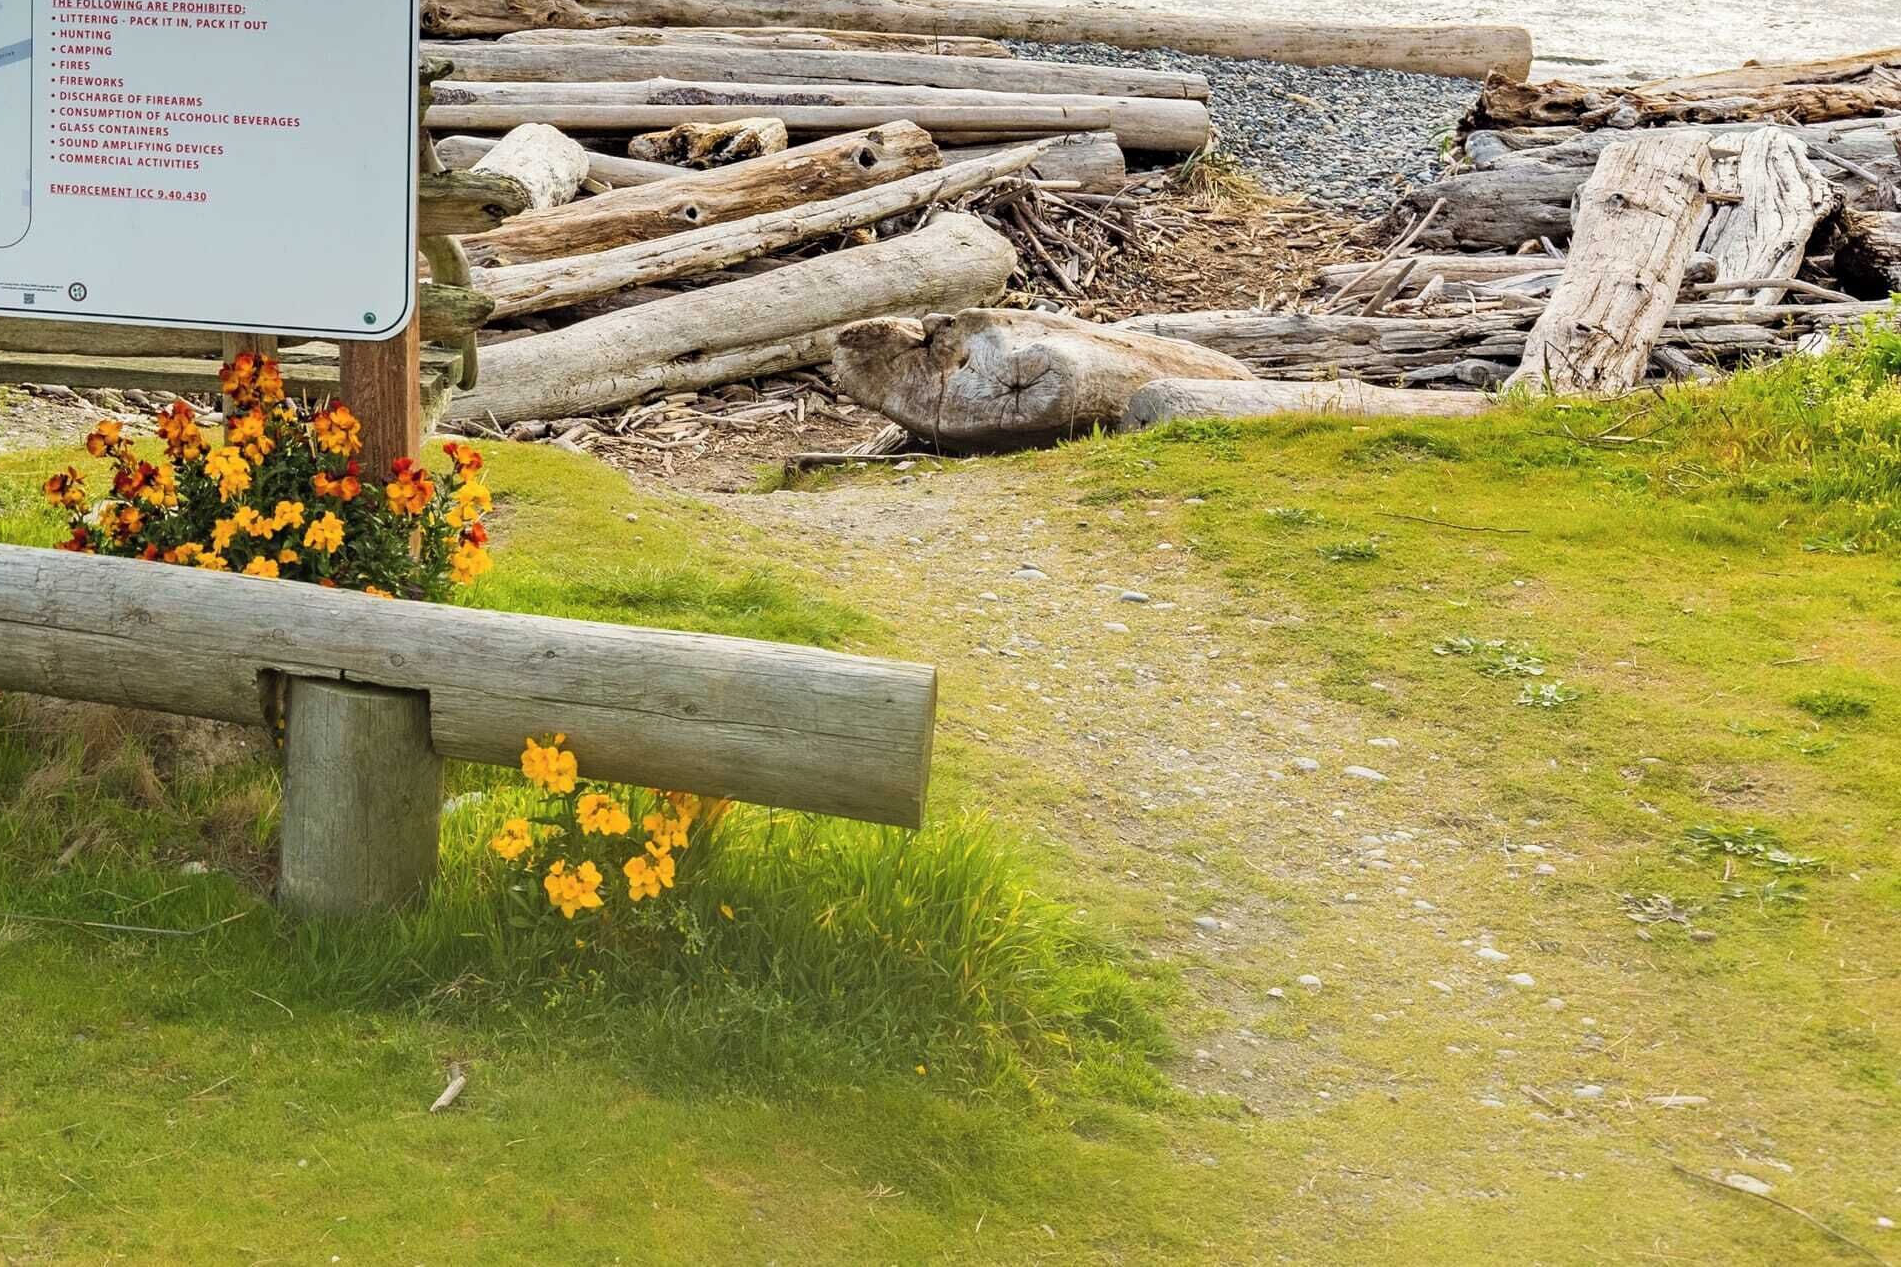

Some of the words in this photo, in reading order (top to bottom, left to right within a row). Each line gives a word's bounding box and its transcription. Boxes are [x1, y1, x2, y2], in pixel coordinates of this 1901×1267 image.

[76, 0, 143, 10] FOLLOWING
[147, 1, 169, 11] ARE
[173, 2, 246, 13] PROHIBITED:
[60, 14, 118, 25] LITTERING
[130, 16, 158, 26] PACK
[162, 17, 173, 27] IT
[196, 19, 225, 29] PACK
[229, 20, 239, 29] IT
[243, 20, 268, 30] OUT
[60, 29, 112, 40] HUNTING
[60, 45, 112, 56] CAMPING
[60, 61, 90, 70] FIRES
[60, 76, 124, 87] FIREWORKS
[60, 91, 123, 103] DISCHARGE
[127, 94, 142, 104] OF
[146, 95, 203, 106] FIREARMS
[60, 107, 142, 120] CONSUMPTION
[146, 110, 161, 120] OF
[165, 111, 229, 123] ALCOHOLIC
[234, 114, 300, 126] BEVERAGES
[60, 123, 94, 133] GLASS
[98, 124, 169, 136] CONTAINERS
[59, 138, 98, 148] SOUND
[102, 140, 172, 151] AMPLIFYING
[176, 143, 224, 154] DEVICES
[59, 153, 133, 165] COMMERCIAL
[137, 156, 199, 168] ACTIVITIES
[50, 184, 132, 197] ENFORCEMENT
[136, 188, 154, 198] ICC
[158, 189, 207, 201] 9.40.430
